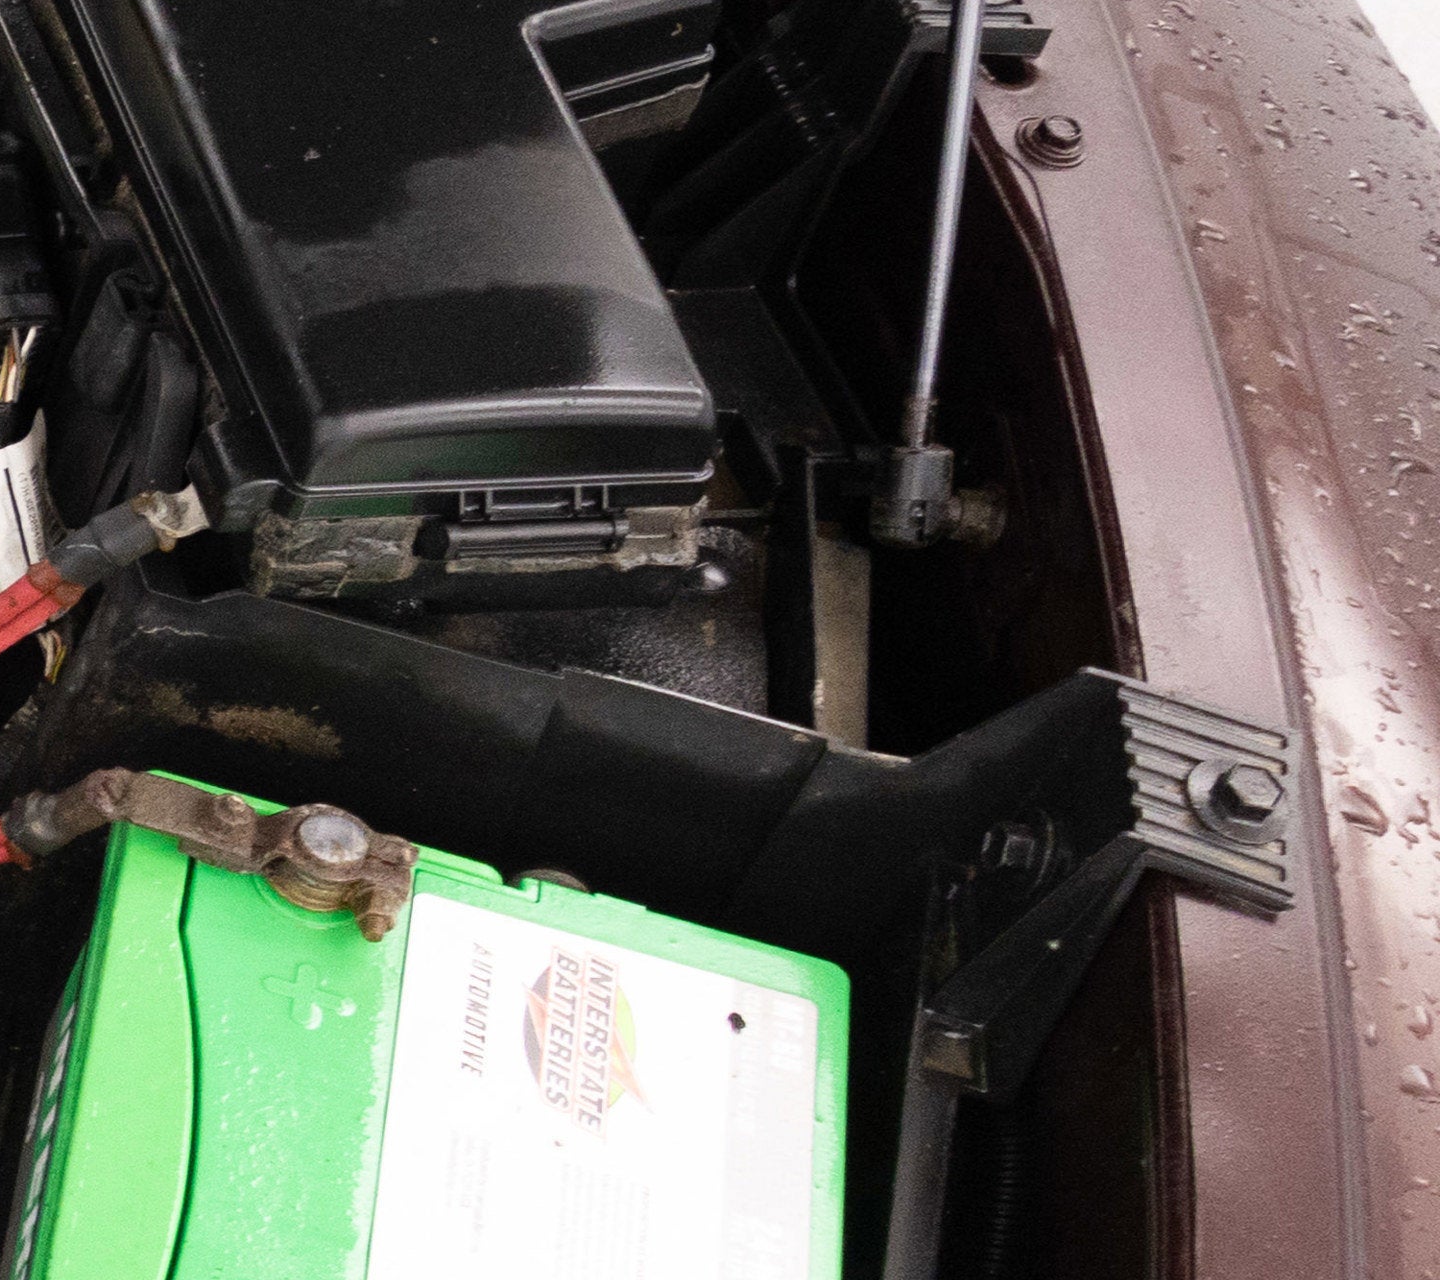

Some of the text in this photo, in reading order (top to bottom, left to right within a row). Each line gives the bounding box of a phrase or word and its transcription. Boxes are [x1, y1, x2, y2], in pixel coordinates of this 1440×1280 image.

[459, 943, 494, 1078] AUTOMOTIVE
[544, 951, 580, 1110] BATTERIES
[574, 956, 615, 1130] INTERSTATE
